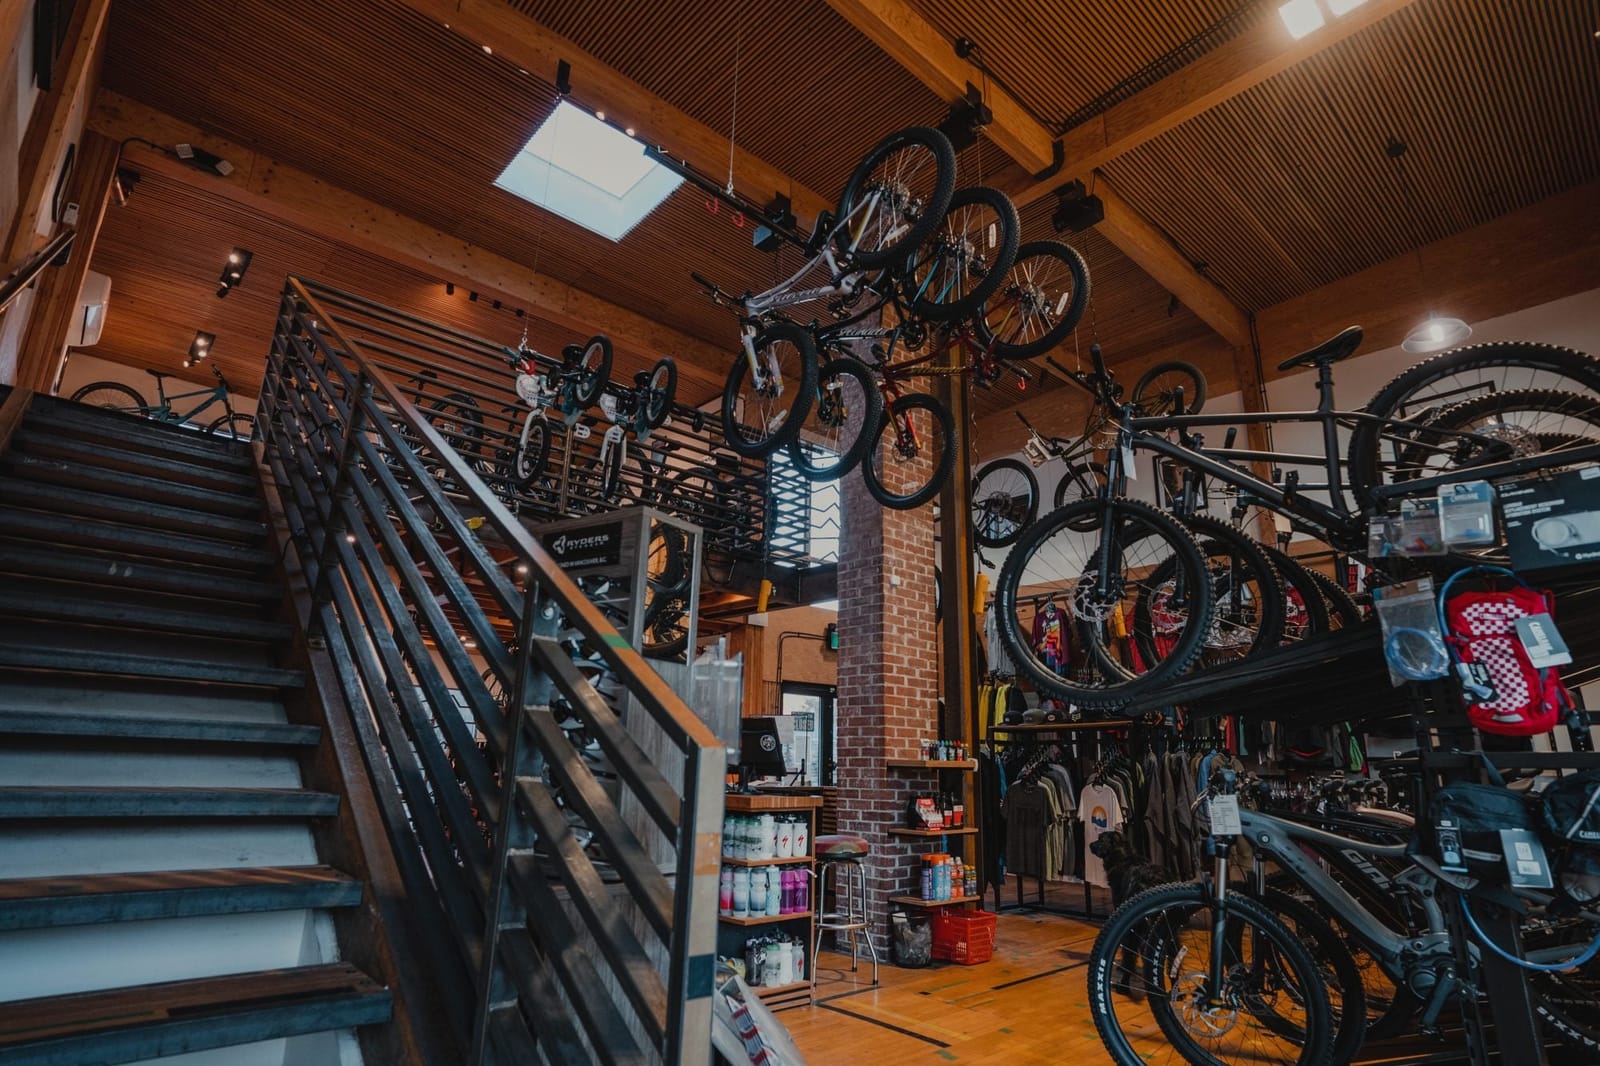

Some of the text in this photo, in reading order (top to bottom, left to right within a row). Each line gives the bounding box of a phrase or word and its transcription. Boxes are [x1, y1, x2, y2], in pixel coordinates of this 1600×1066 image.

[566, 534, 609, 547] RYDERS
[1097, 958, 1108, 1015] MAXXIS
[1152, 938, 1165, 987] MAXXIS
